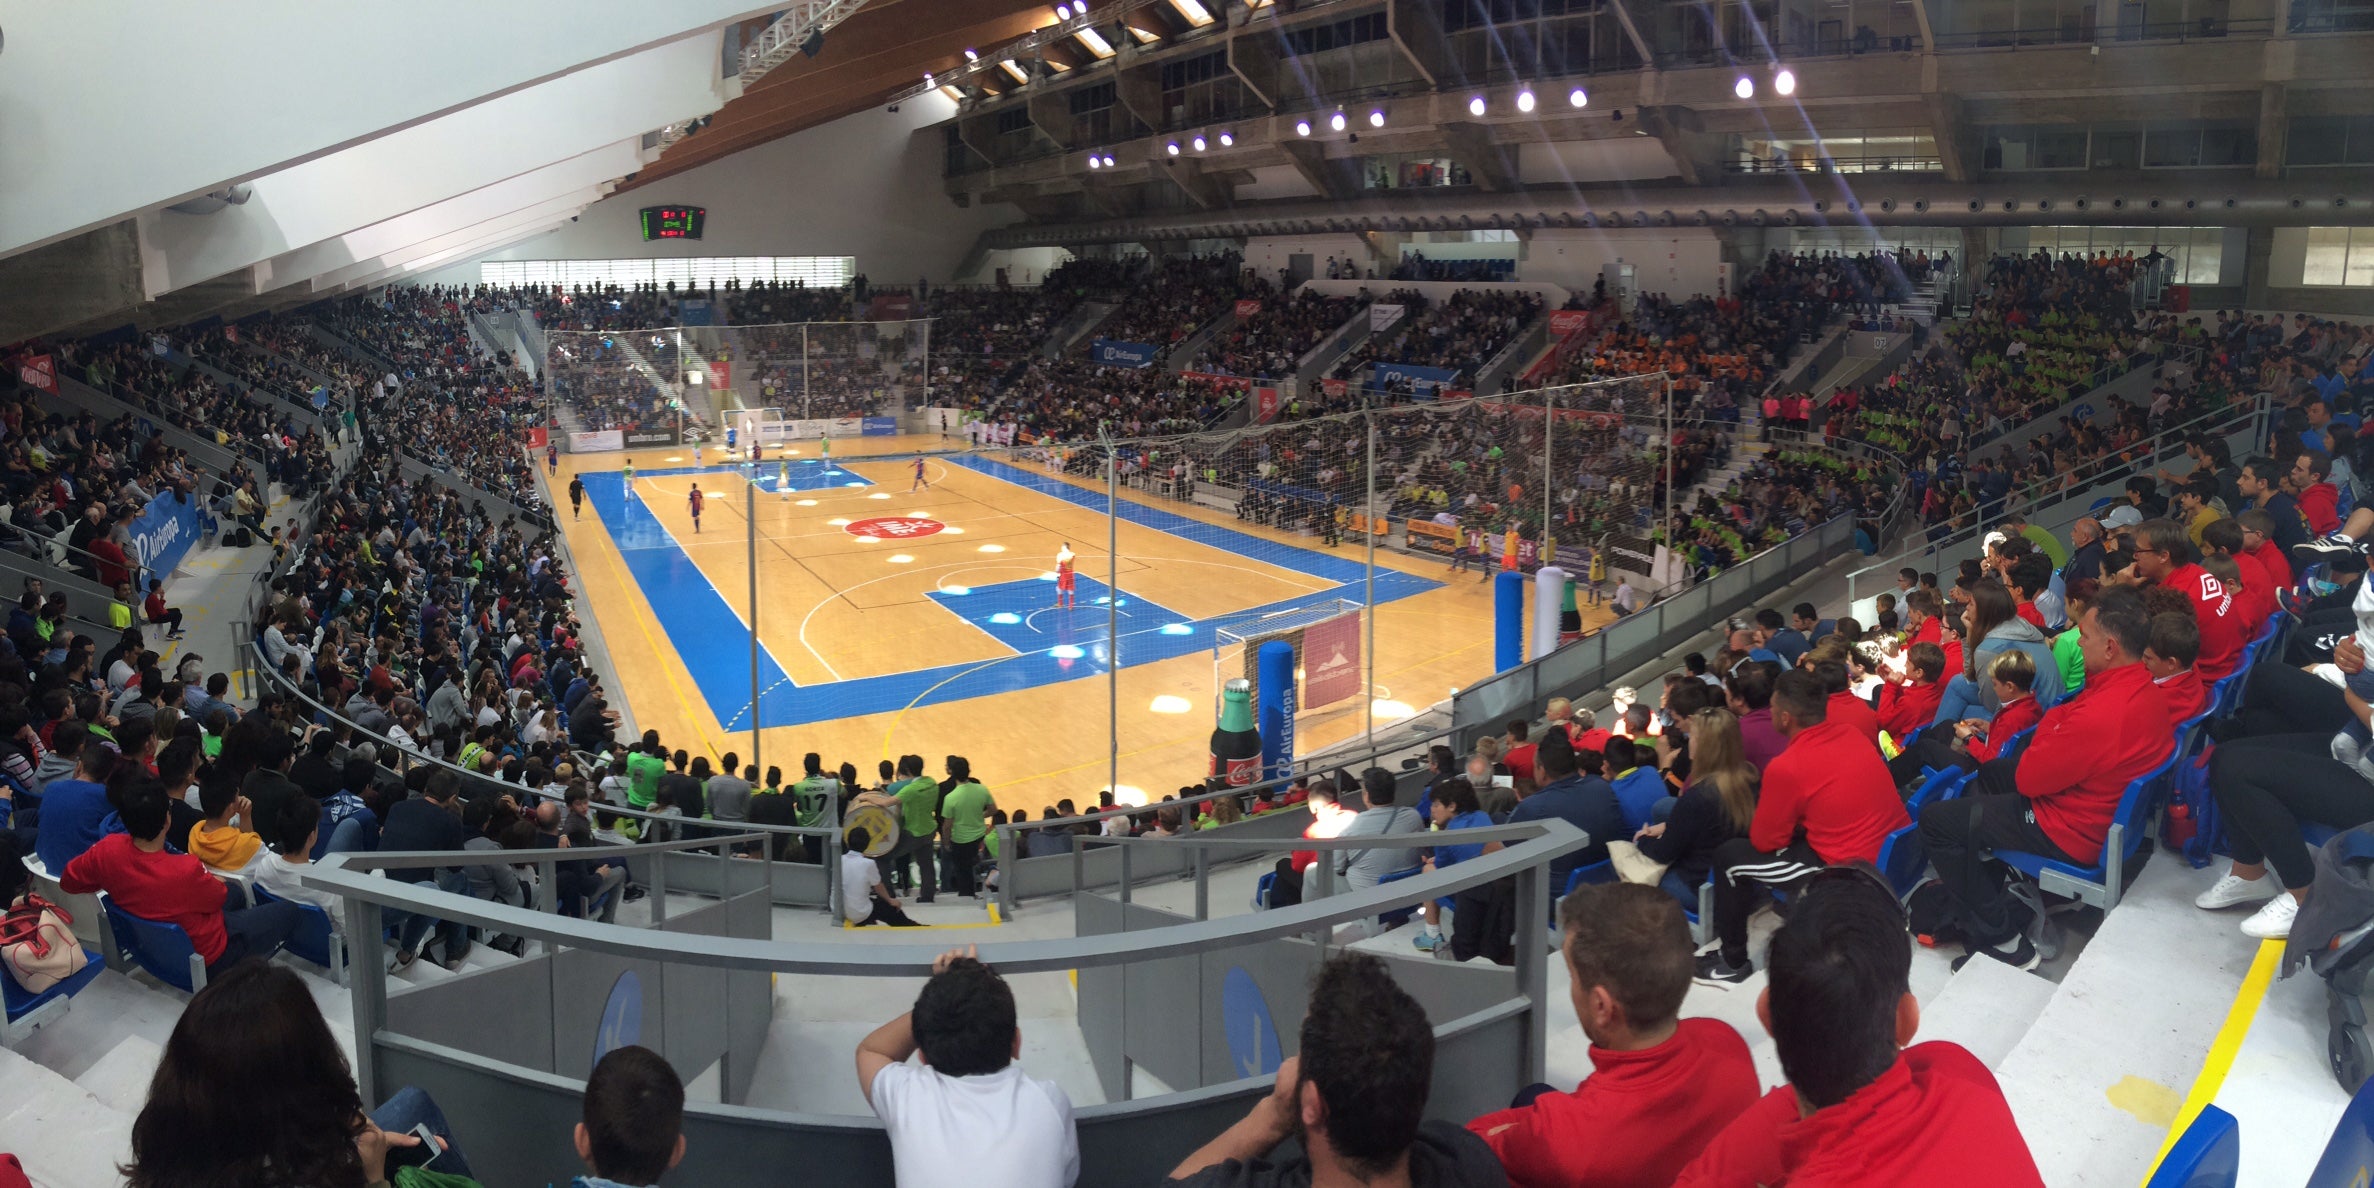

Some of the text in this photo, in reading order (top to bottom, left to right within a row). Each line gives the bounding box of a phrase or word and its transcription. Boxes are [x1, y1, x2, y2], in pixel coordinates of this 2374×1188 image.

[1875, 339, 1886, 348] 07
[149, 515, 180, 561] AirEuropa
[1280, 688, 1292, 754] AirEuropa
[804, 793, 828, 812] 17
